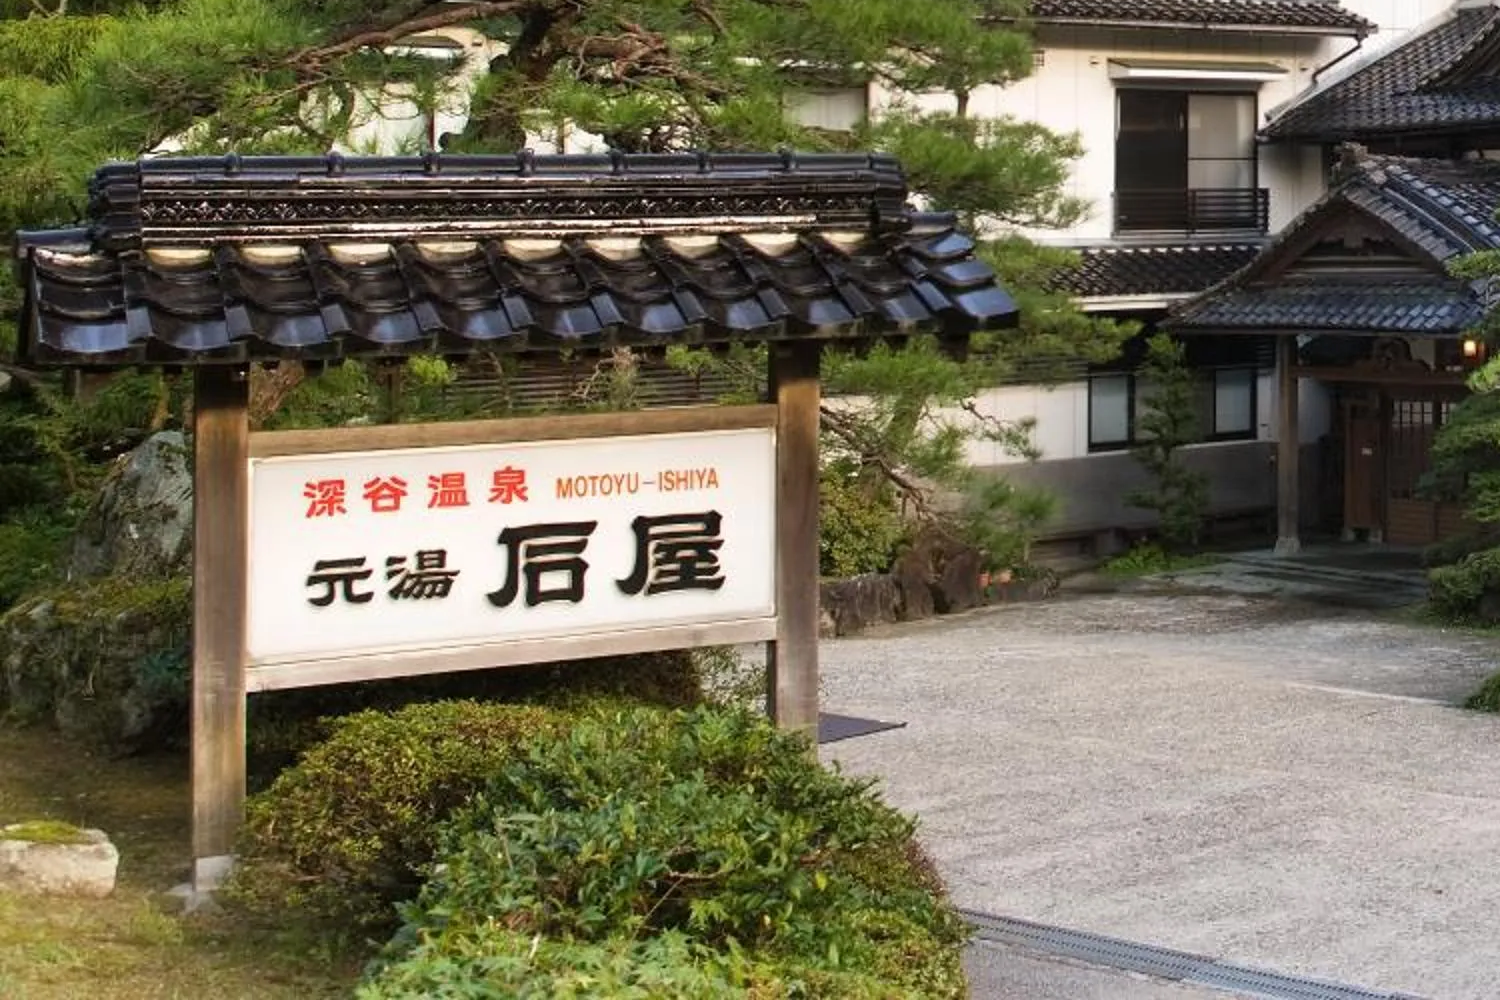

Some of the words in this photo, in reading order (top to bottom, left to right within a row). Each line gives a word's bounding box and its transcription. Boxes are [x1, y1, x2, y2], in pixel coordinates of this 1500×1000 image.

[303, 465, 529, 518] 深谷温泉
[555, 467, 719, 499] MOTOYU-ISHIYA
[305, 549, 460, 607] 元湯
[486, 509, 726, 608] 石屋
